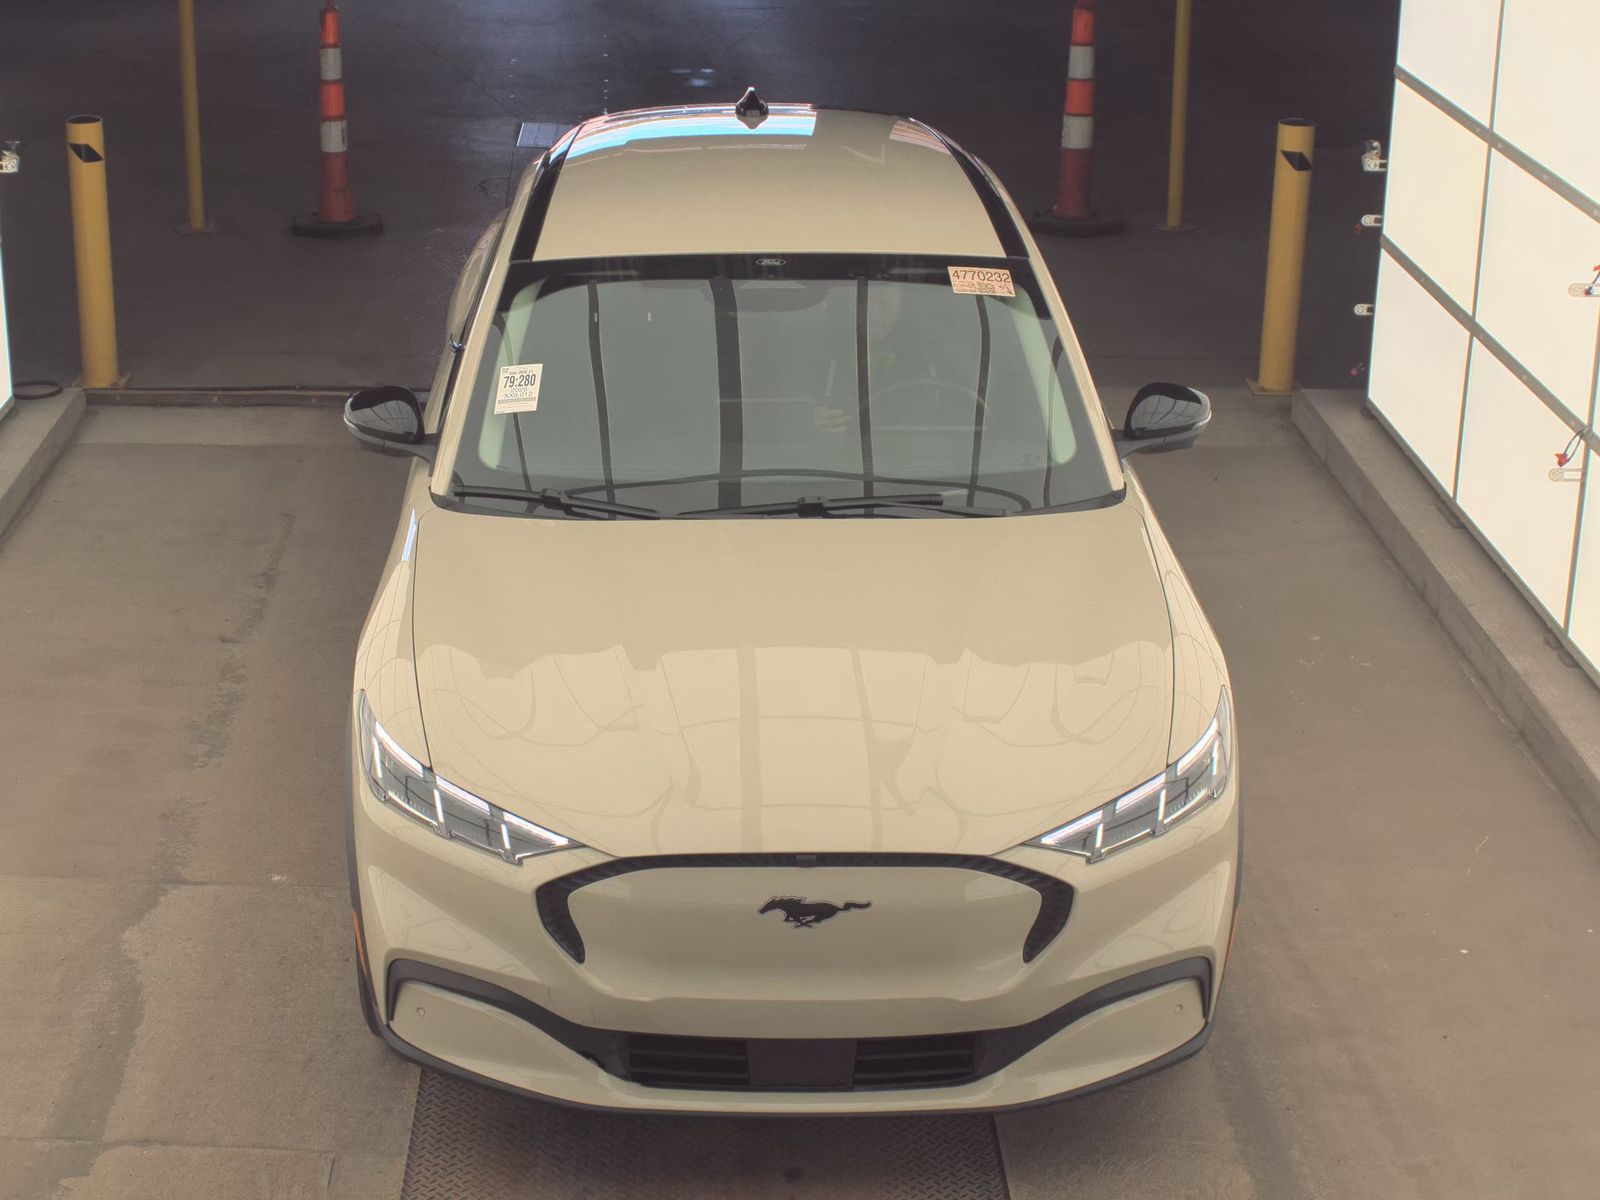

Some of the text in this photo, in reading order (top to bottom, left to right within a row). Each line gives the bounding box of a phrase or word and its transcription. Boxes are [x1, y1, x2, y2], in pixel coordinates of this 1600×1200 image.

[759, 258, 783, 266] Ford
[952, 270, 1011, 283] 4770232
[504, 374, 536, 388] 79:280
